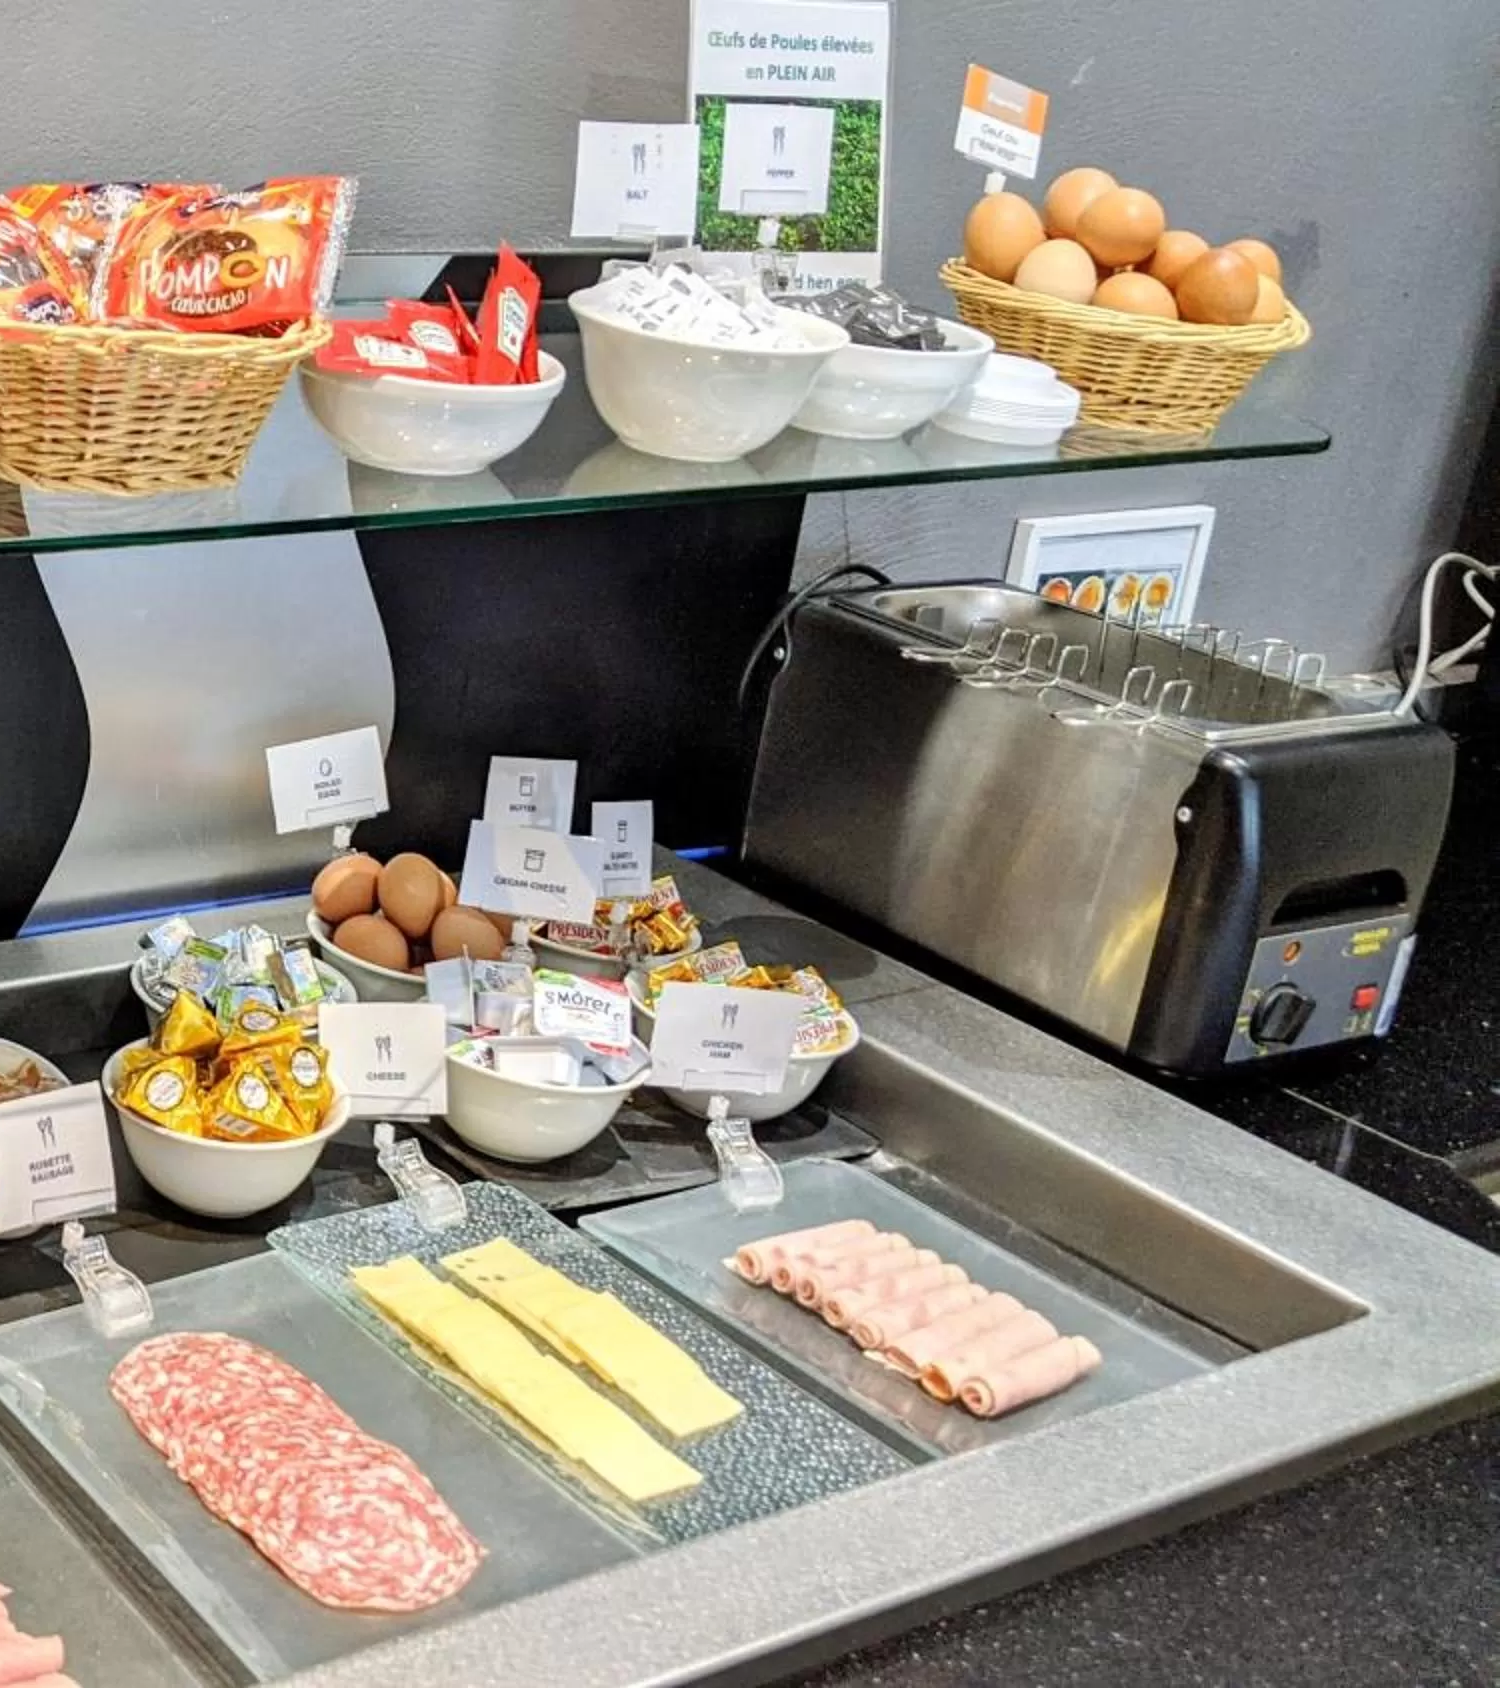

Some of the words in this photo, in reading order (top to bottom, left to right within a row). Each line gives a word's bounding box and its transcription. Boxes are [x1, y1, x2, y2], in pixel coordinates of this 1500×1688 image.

[750, 32, 768, 49] de
[771, 34, 818, 52] Poules
[821, 36, 875, 54] élevées
[746, 67, 764, 81] en
[767, 64, 809, 82] PLEIN
[811, 65, 837, 82] AIR
[807, 273, 833, 289] hen
[366, 1071, 407, 1081] CHEESE
